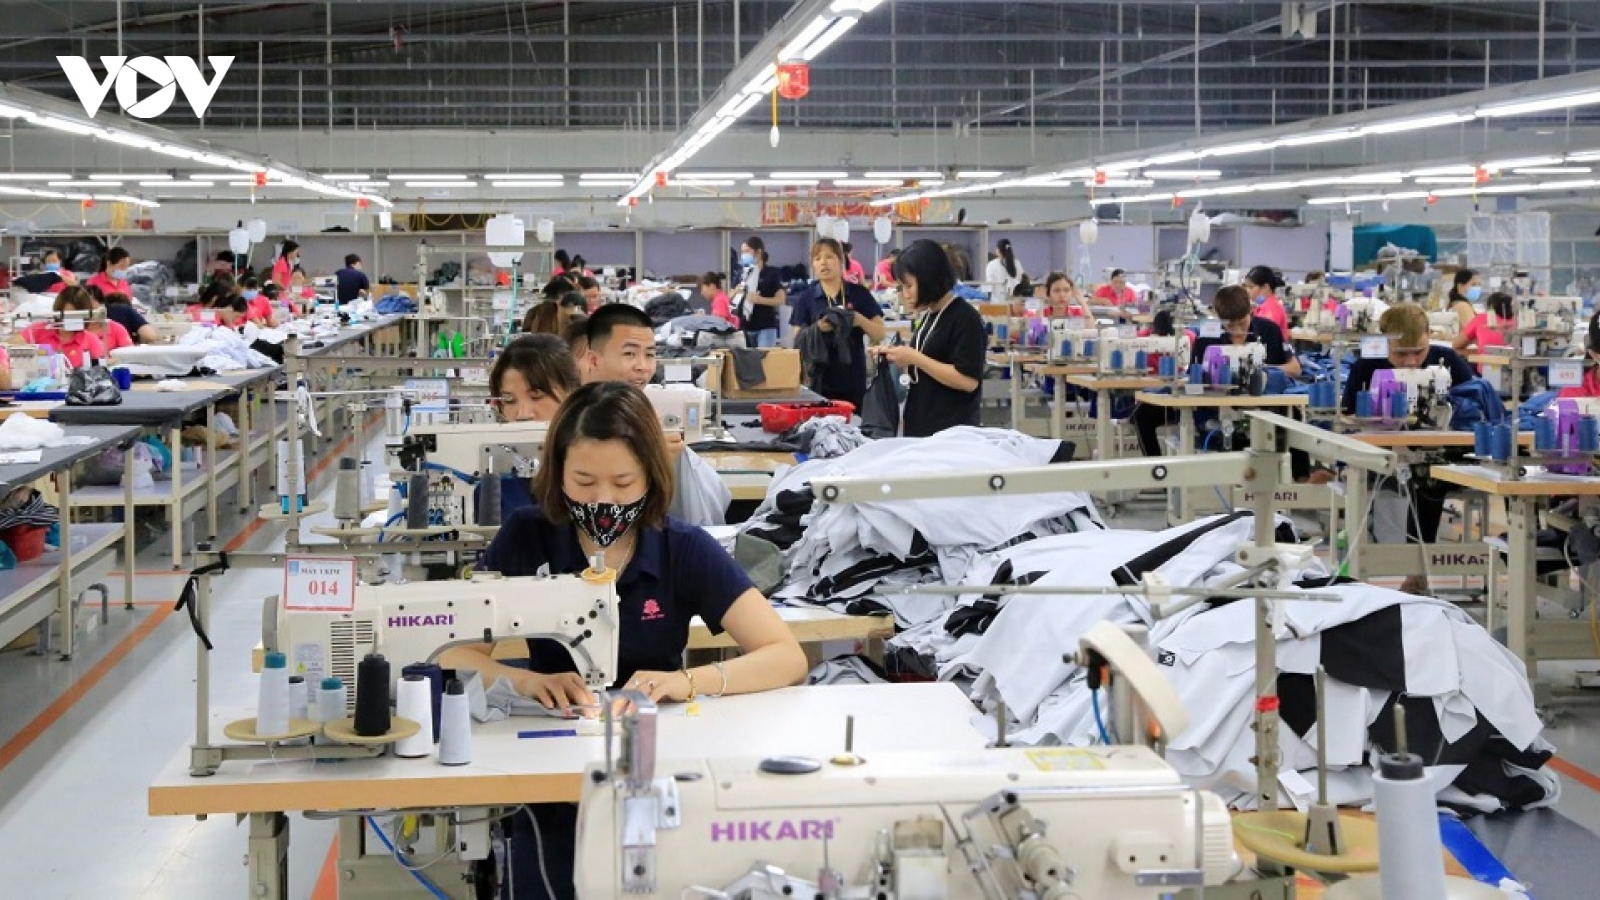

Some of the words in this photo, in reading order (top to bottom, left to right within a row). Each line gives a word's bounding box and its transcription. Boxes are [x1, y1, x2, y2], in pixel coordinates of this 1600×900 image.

[1244, 491, 1298, 502] HARI
[1431, 553, 1490, 566] HIKAR
[308, 580, 338, 595] 014
[387, 613, 455, 628] HIKARI
[710, 818, 834, 842] HIKARI
